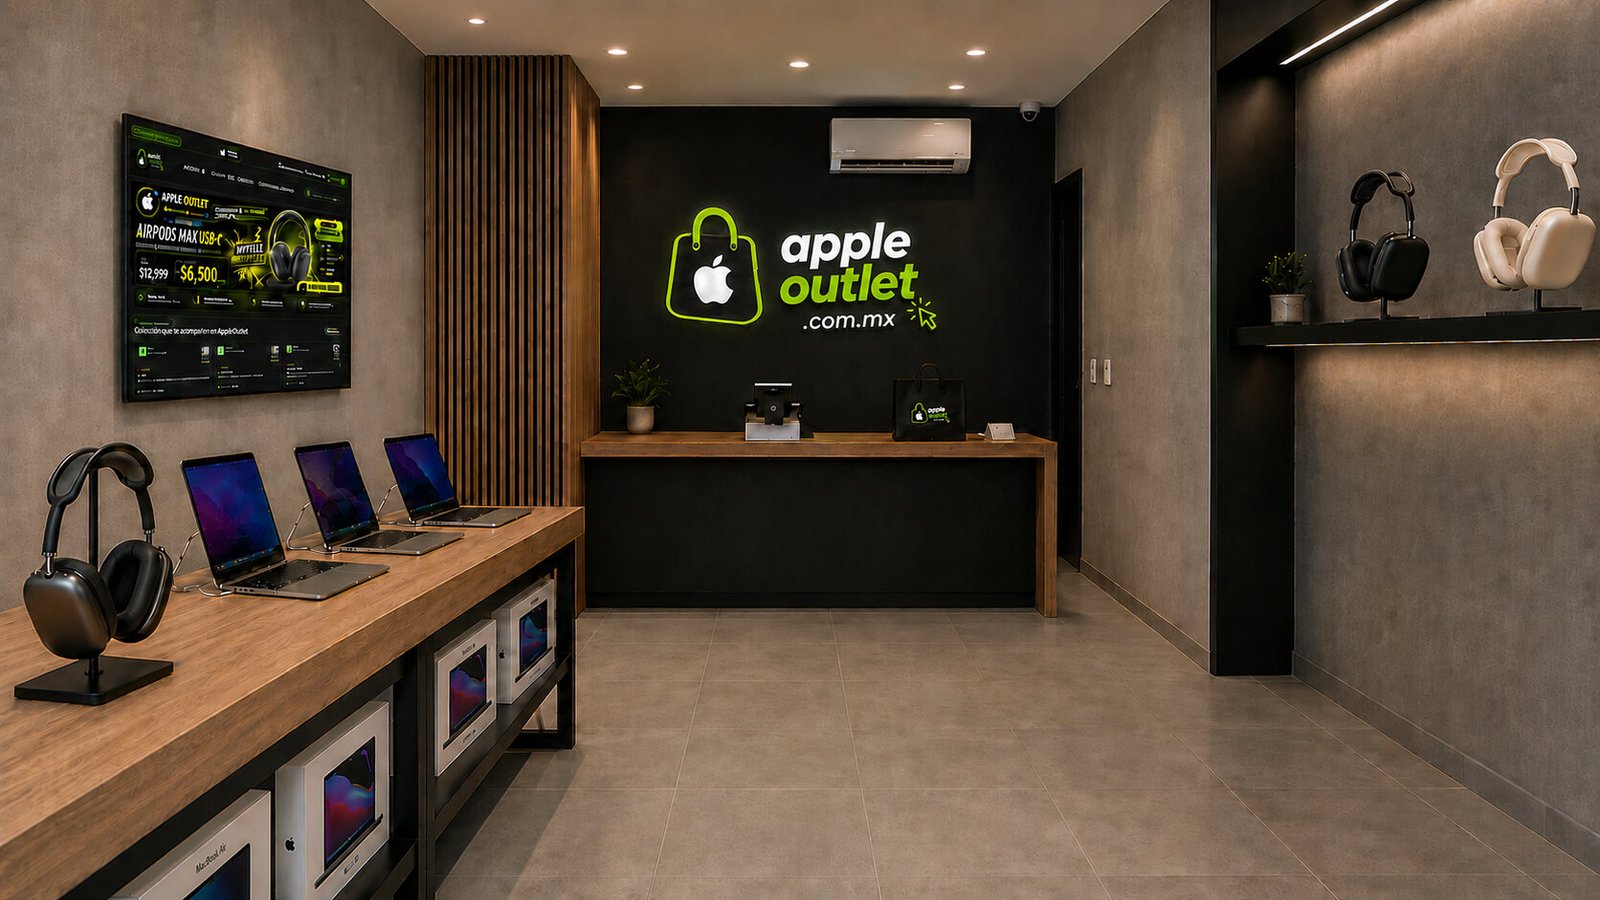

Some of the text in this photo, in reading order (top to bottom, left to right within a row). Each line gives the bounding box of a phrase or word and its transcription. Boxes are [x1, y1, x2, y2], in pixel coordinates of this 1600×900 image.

[161, 192, 209, 209] APPLE OUTLET
[135, 223, 223, 246] AIRPODS MAX USB-C
[780, 221, 912, 270] apple
[139, 266, 169, 281] $12,999
[180, 264, 218, 285] $6,500
[779, 263, 919, 305] outlet
[802, 312, 896, 331] .com.mx
